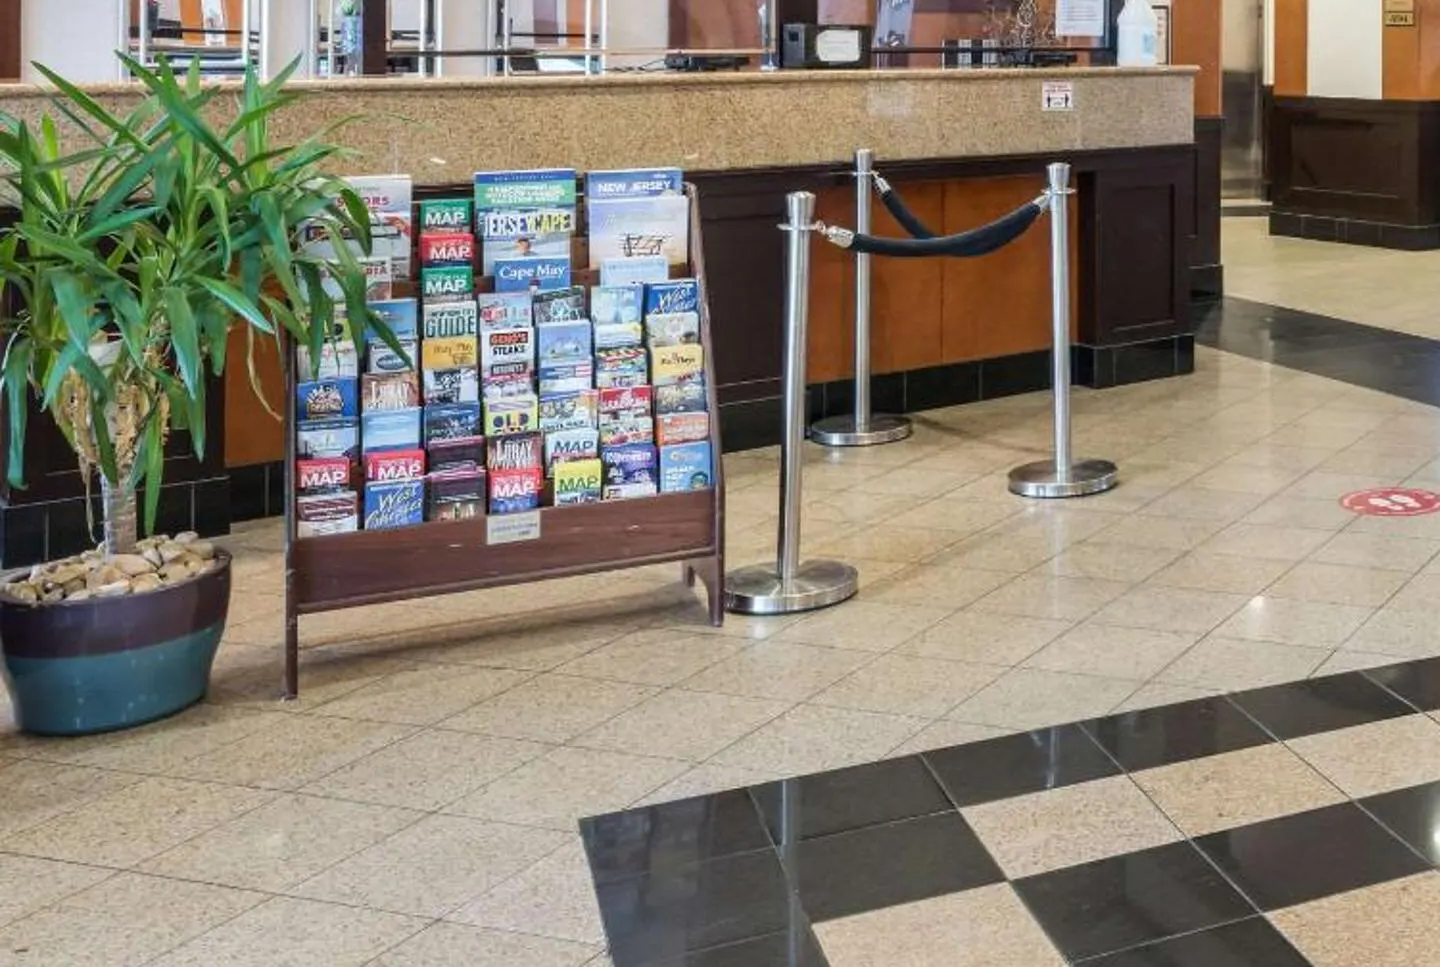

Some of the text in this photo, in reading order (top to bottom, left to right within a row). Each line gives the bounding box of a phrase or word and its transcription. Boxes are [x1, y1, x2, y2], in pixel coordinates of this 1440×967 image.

[598, 179, 672, 193] NEW JERSEY
[425, 210, 467, 226] MAP
[429, 243, 473, 261] MAP
[499, 263, 567, 282] Cape May
[425, 278, 468, 295] MAP
[425, 315, 476, 338] GUIDE
[554, 440, 594, 454] MAP
[300, 470, 346, 488] MAP
[378, 462, 422, 480] MAP
[494, 481, 534, 498] MAP
[559, 477, 599, 493] MAP
